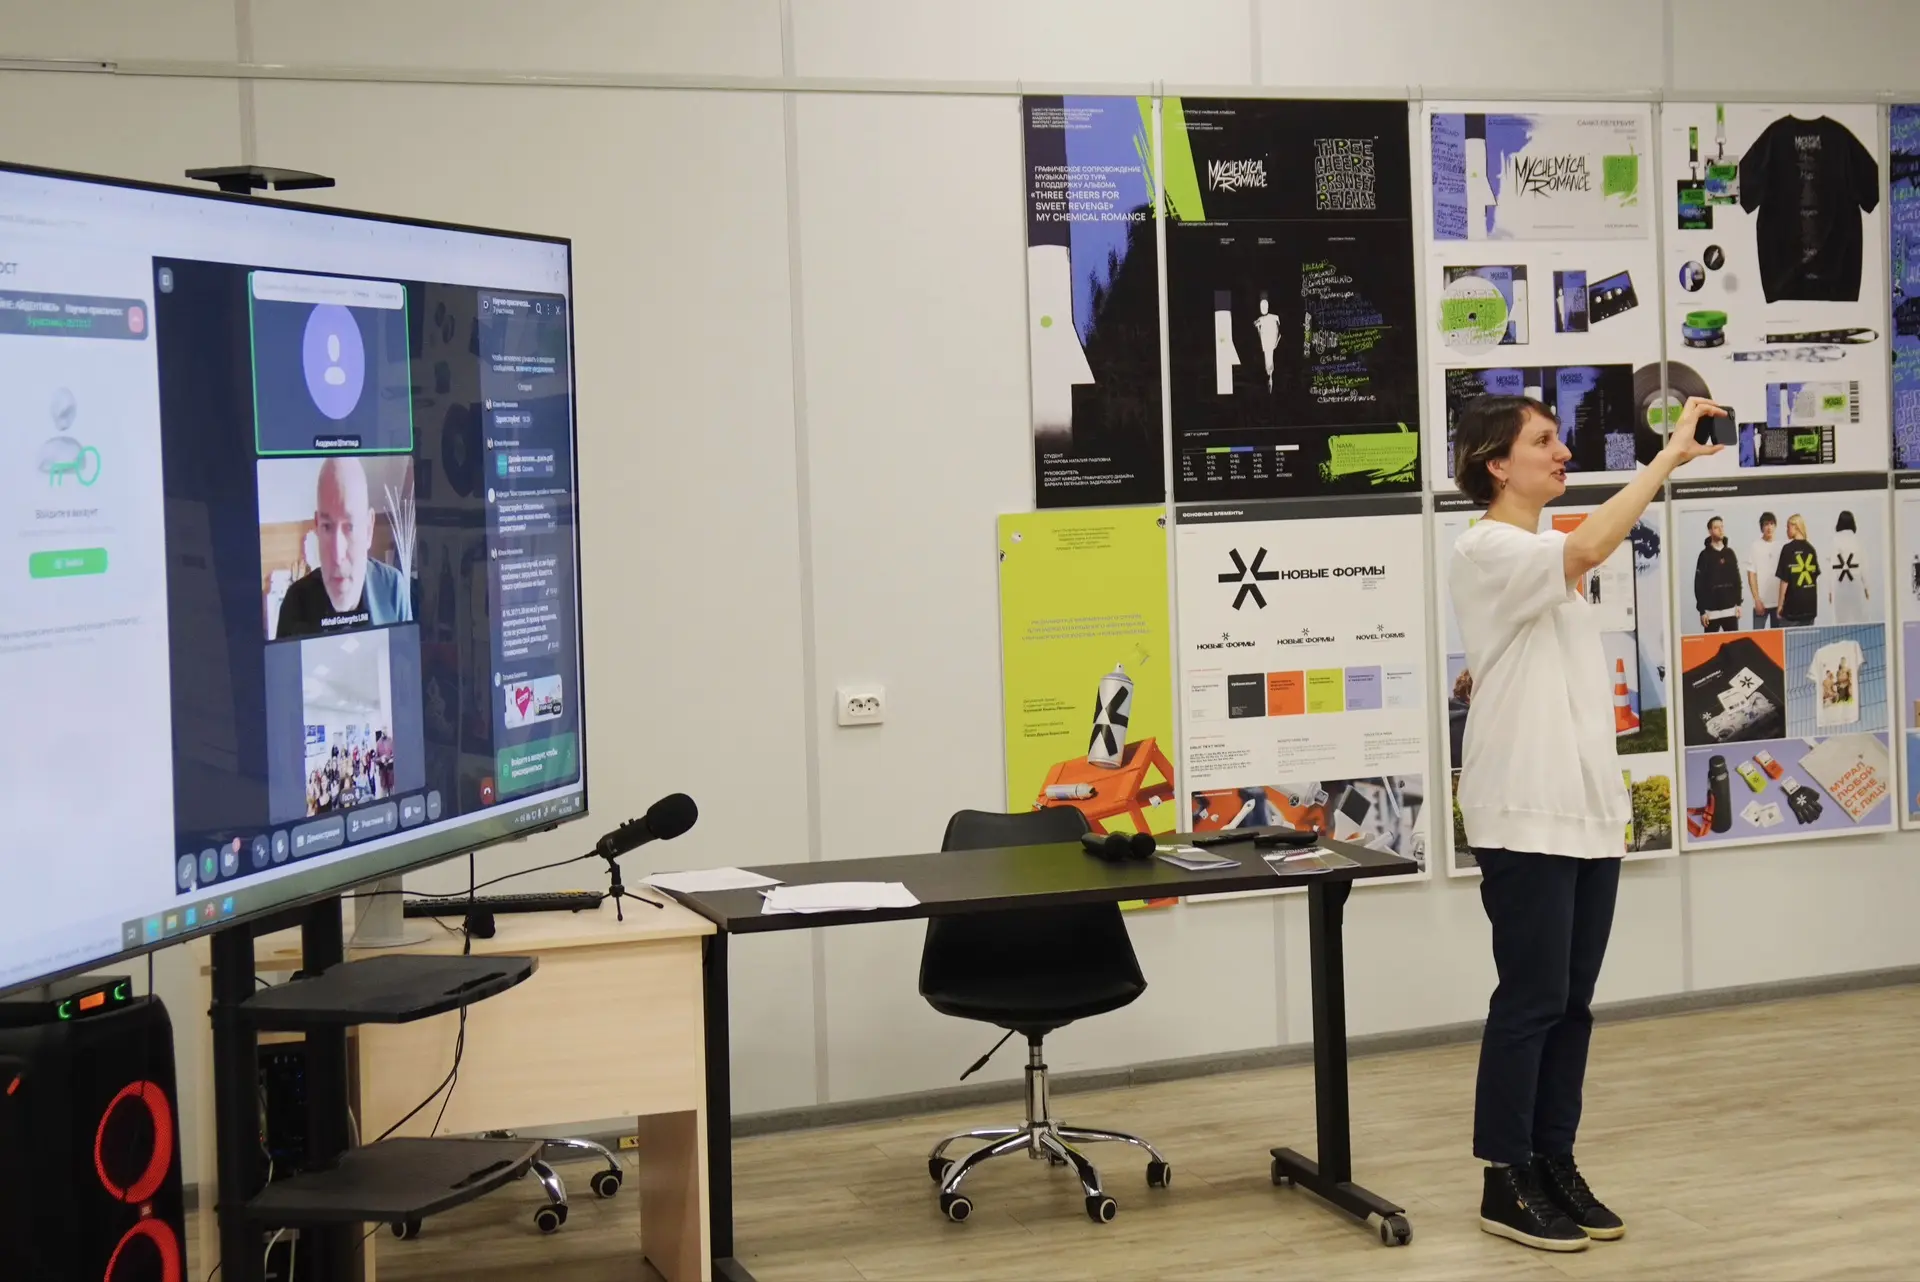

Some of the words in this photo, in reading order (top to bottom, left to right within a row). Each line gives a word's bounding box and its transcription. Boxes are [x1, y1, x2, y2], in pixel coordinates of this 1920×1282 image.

[1314, 139, 1374, 159] THREE
[1219, 173, 1268, 192] ROMANCE
[1527, 174, 1592, 198] ROMANCE
[1031, 191, 1063, 199] «THREE
[1065, 191, 1100, 199] CHEERS
[1102, 191, 1120, 199] FOR
[1036, 202, 1066, 210] SWEET
[1068, 202, 1114, 210] REVENGE»
[1036, 213, 1051, 221] MY
[1053, 213, 1099, 221] CHEMICAL
[1101, 213, 1146, 221] ROMANCE
[1281, 568, 1329, 580] НОВЫЕ
[1332, 565, 1385, 578] ФОРМЫ
[1226, 641, 1255, 649] ФОРМЫ
[1305, 636, 1335, 644] ФОРМЫ
[1830, 762, 1865, 792] МУРАЛ
[1838, 766, 1875, 800] ЛЮБОЙ
[1844, 779, 1877, 808] СТЕНЕ
[1860, 782, 1886, 808] ЛИЦУ
